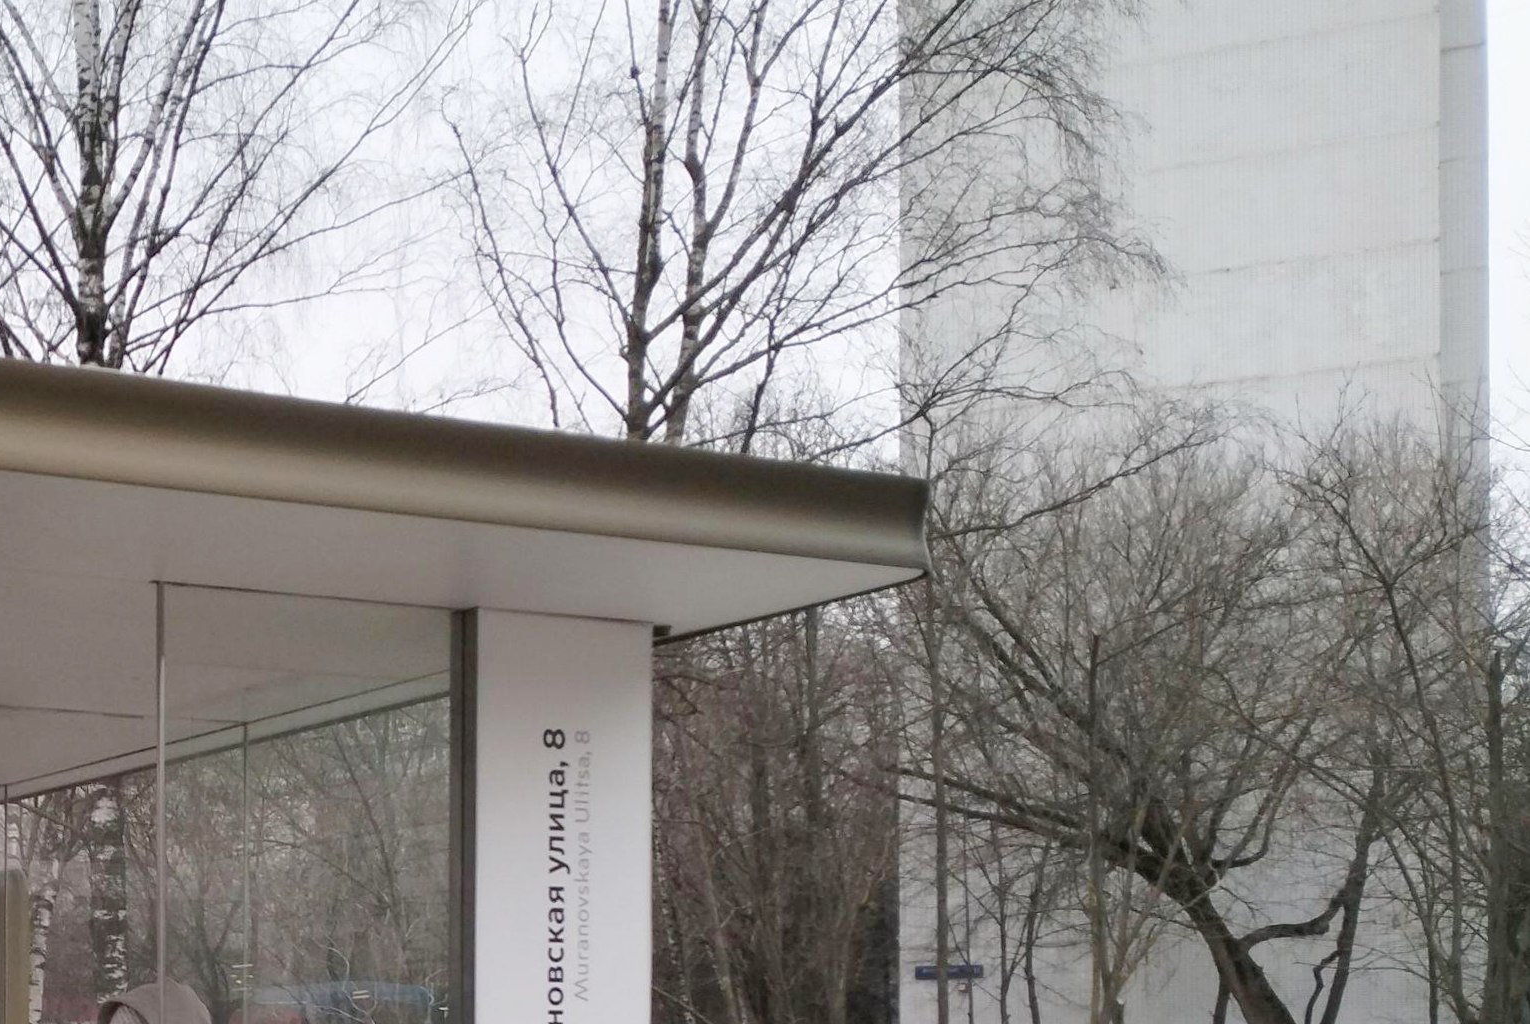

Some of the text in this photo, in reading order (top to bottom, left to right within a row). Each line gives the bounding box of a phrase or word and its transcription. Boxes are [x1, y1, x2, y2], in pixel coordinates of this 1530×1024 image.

[543, 729, 566, 750] 8
[548, 760, 571, 875] улица,
[574, 730, 593, 1002] Muranovskaya Ulitsa, 8
